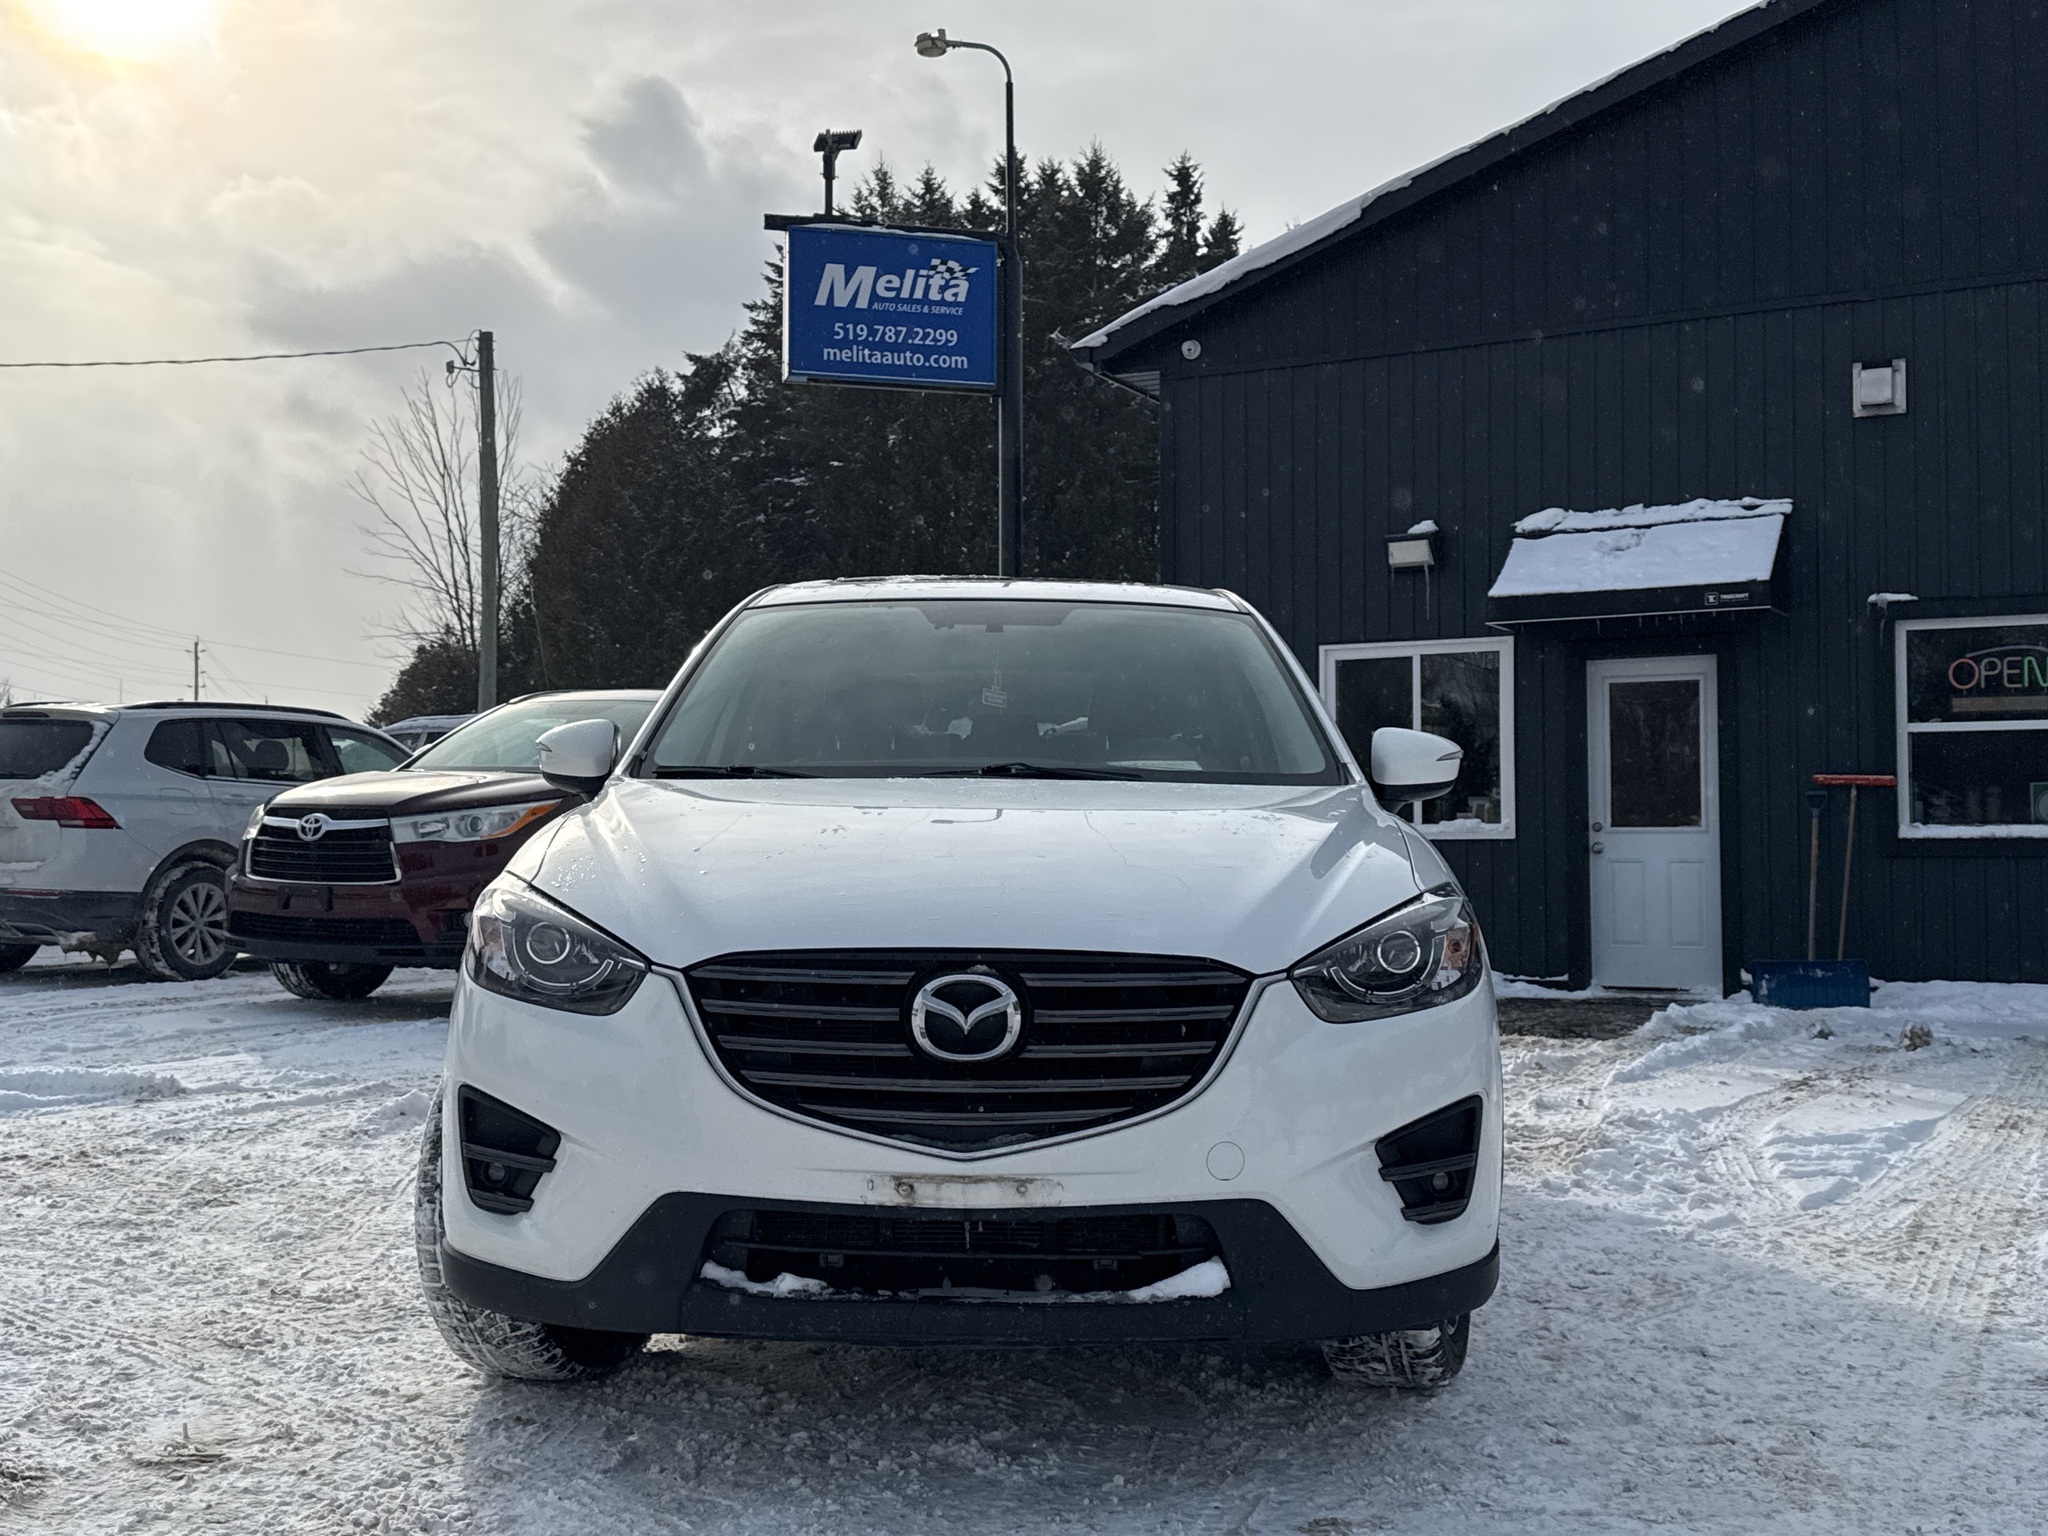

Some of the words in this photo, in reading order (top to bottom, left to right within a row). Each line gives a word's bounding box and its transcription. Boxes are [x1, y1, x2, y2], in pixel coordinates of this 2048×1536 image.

[814, 263, 970, 309] Melita
[872, 302, 896, 311] AUTO
[896, 303, 922, 313] SALES
[922, 305, 930, 313] &
[930, 305, 964, 316] SERVICE
[833, 322, 958, 347] 519.787.2299
[823, 345, 968, 369] melitaauto.com
[1948, 656, 2048, 690] OPEN
